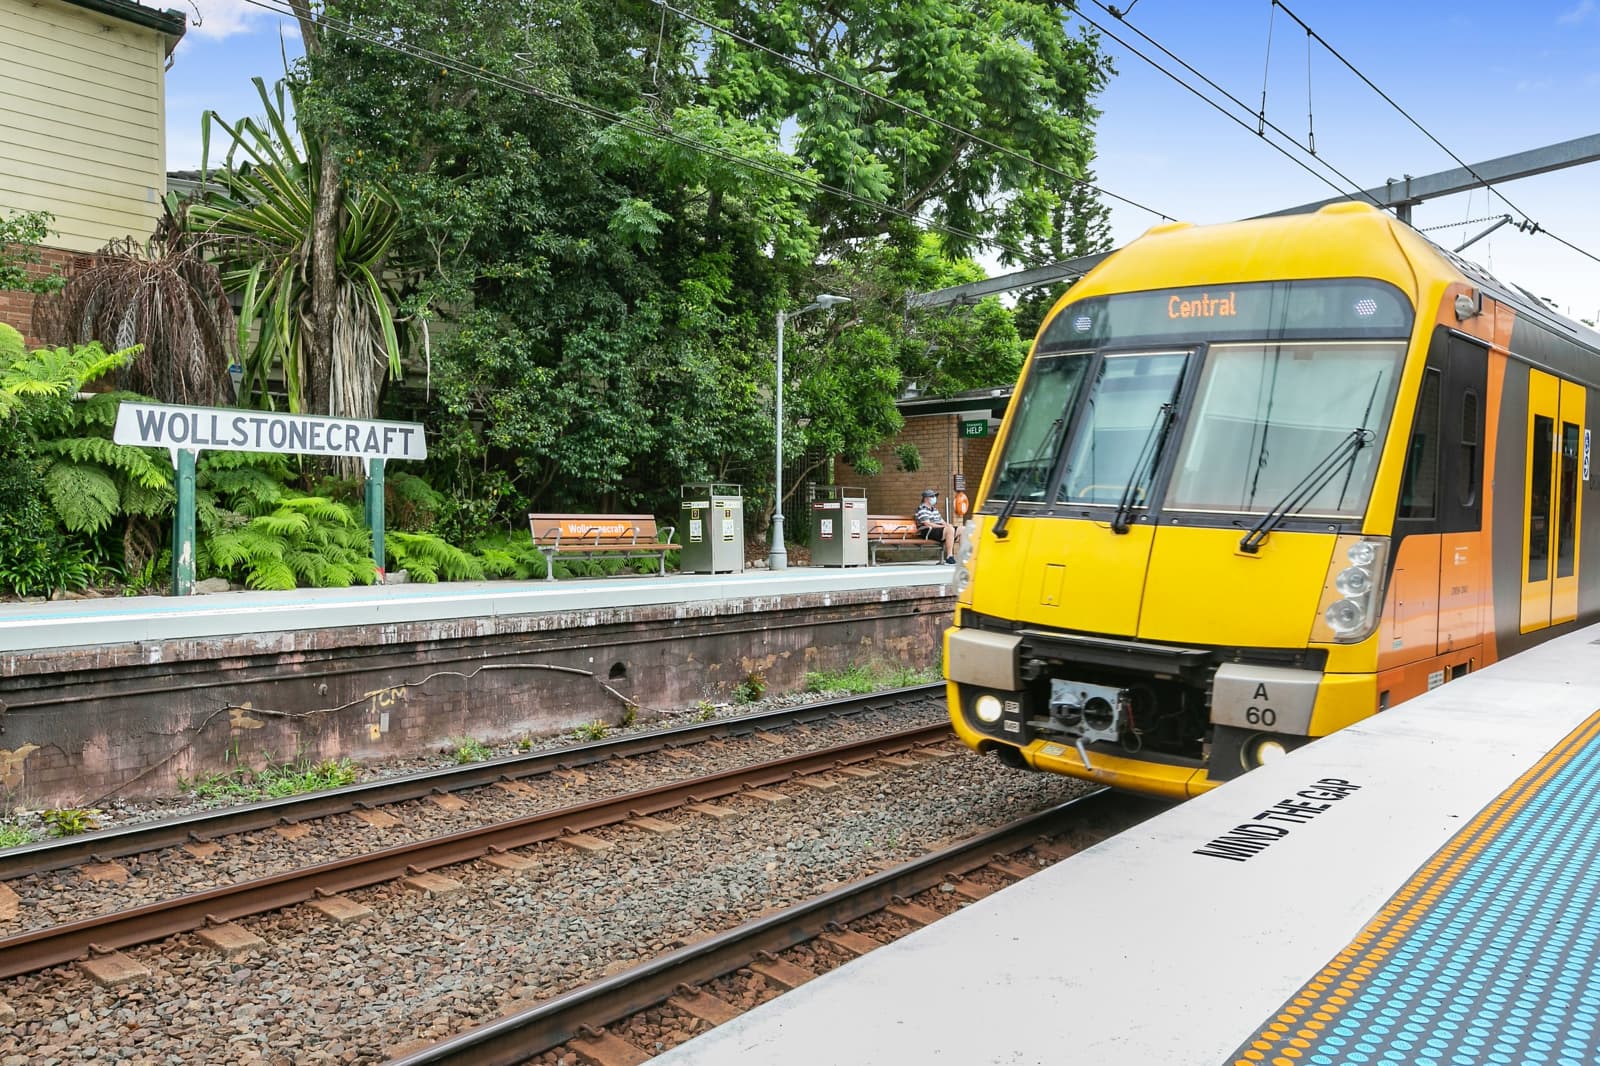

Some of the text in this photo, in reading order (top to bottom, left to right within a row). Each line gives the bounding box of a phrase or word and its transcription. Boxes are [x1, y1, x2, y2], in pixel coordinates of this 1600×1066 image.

[1168, 291, 1236, 319] Central
[136, 410, 415, 455] WOLLSTONECRAFT
[966, 426, 983, 435] HELP
[1253, 683, 1269, 701] A
[1246, 706, 1276, 727] 60
[1192, 778, 1362, 861] MIND THE GAP
